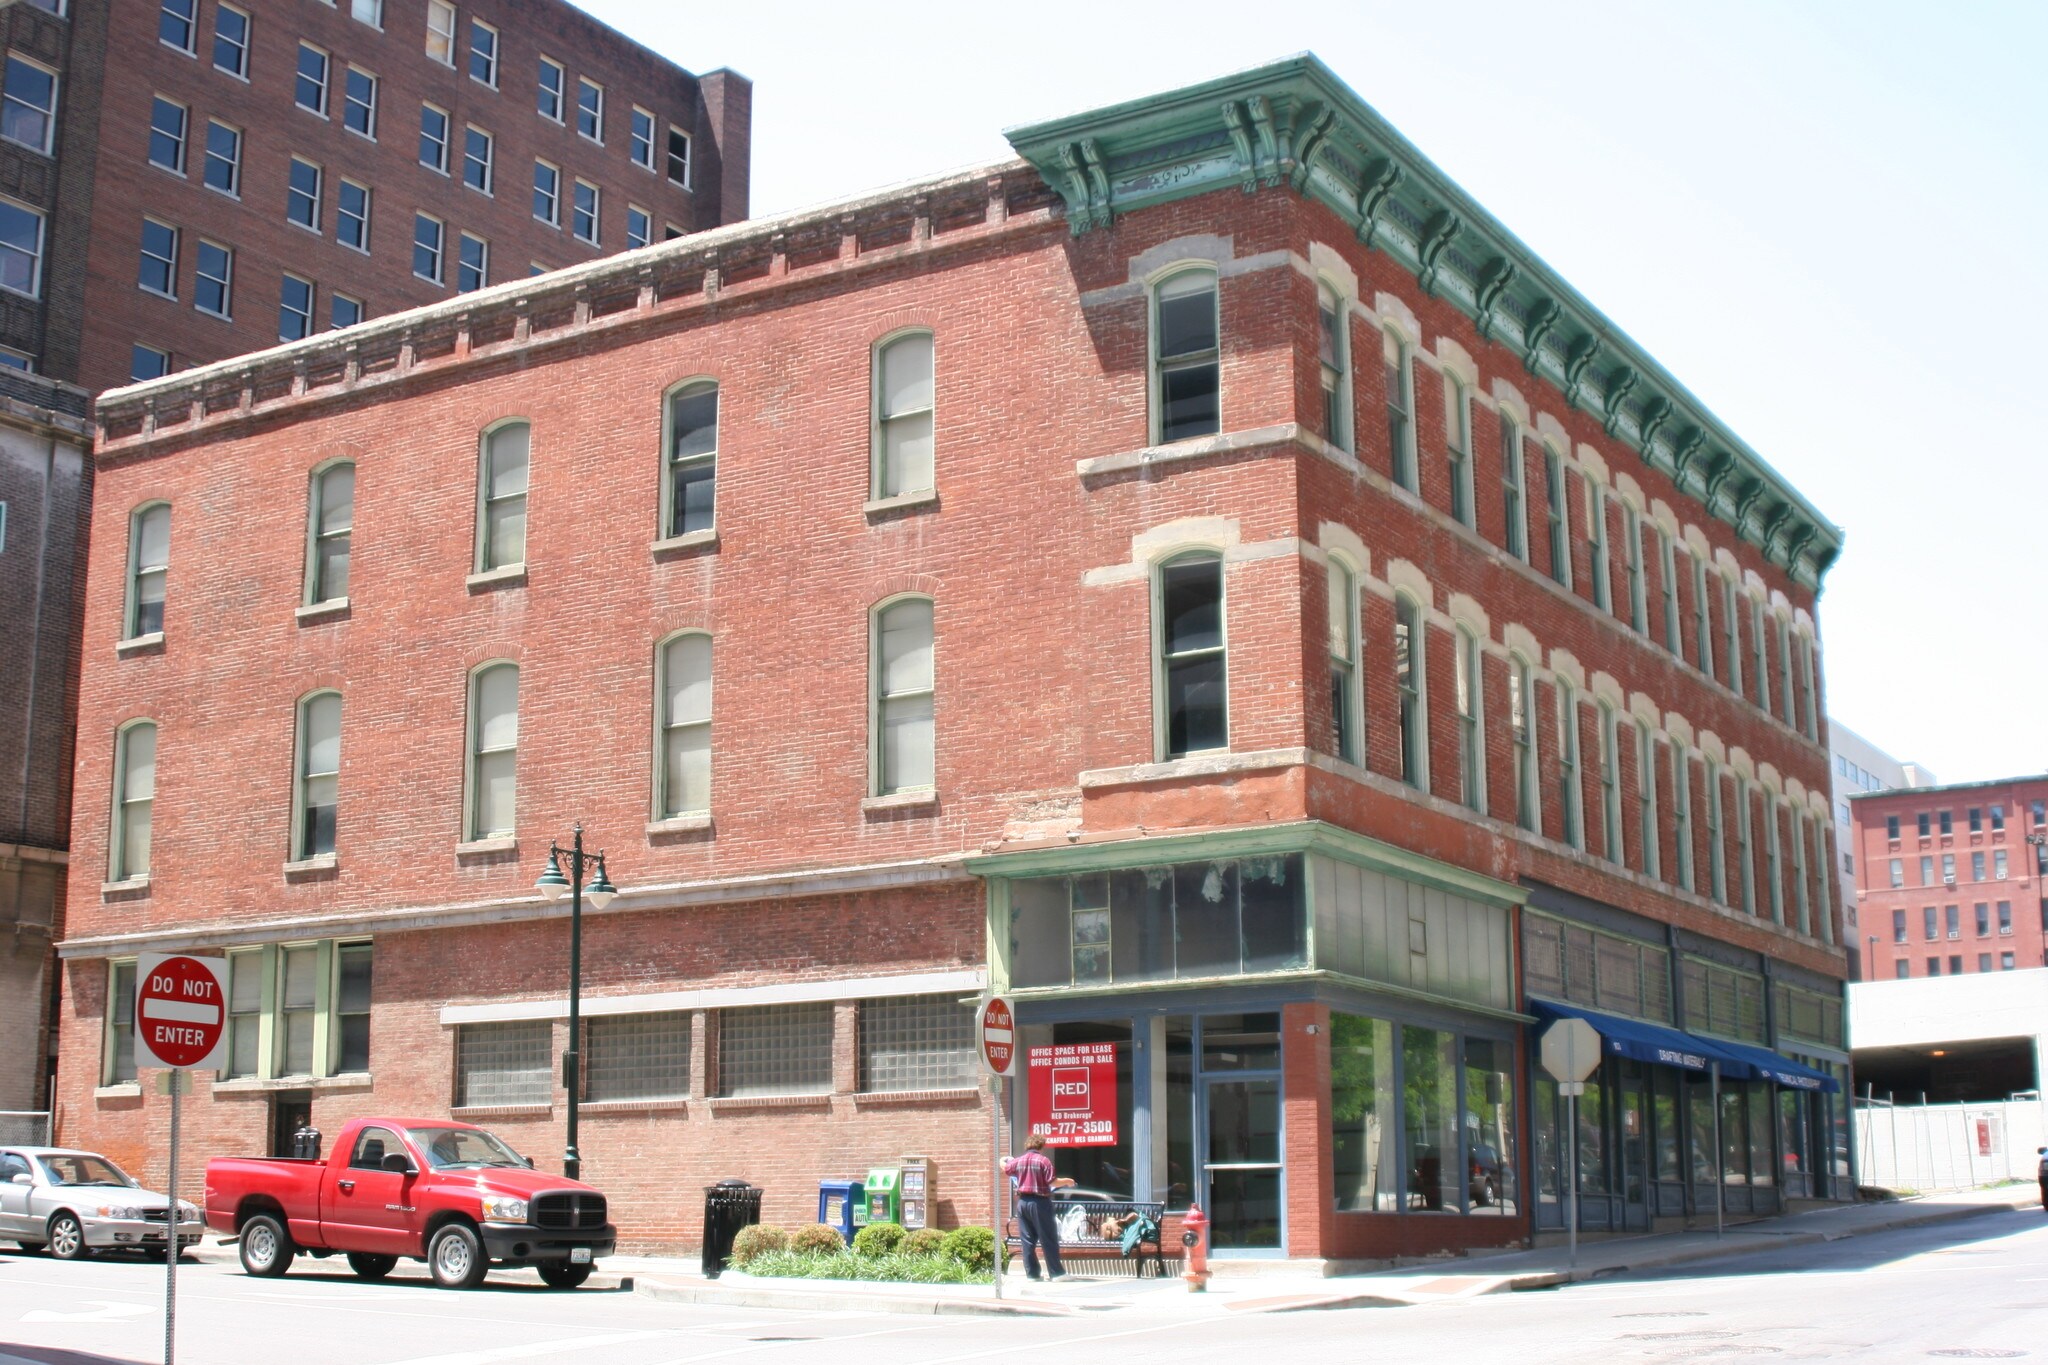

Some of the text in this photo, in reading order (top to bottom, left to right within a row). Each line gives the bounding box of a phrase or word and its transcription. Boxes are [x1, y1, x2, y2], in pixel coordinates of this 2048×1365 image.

[152, 975, 214, 998] DO NOT
[986, 1012, 1010, 1026] DO NOT
[155, 1025, 204, 1046] ENTER
[990, 1045, 1009, 1059] ENTER
[1031, 1044, 1112, 1057] OFFICE SPACE FOR LEASE
[1030, 1054, 1113, 1067] OFFICE CONDOS FOR SALE
[1055, 1082, 1088, 1096] RED
[1051, 1112, 1062, 1120] RED
[1032, 1120, 1112, 1135] 816-777-3500
